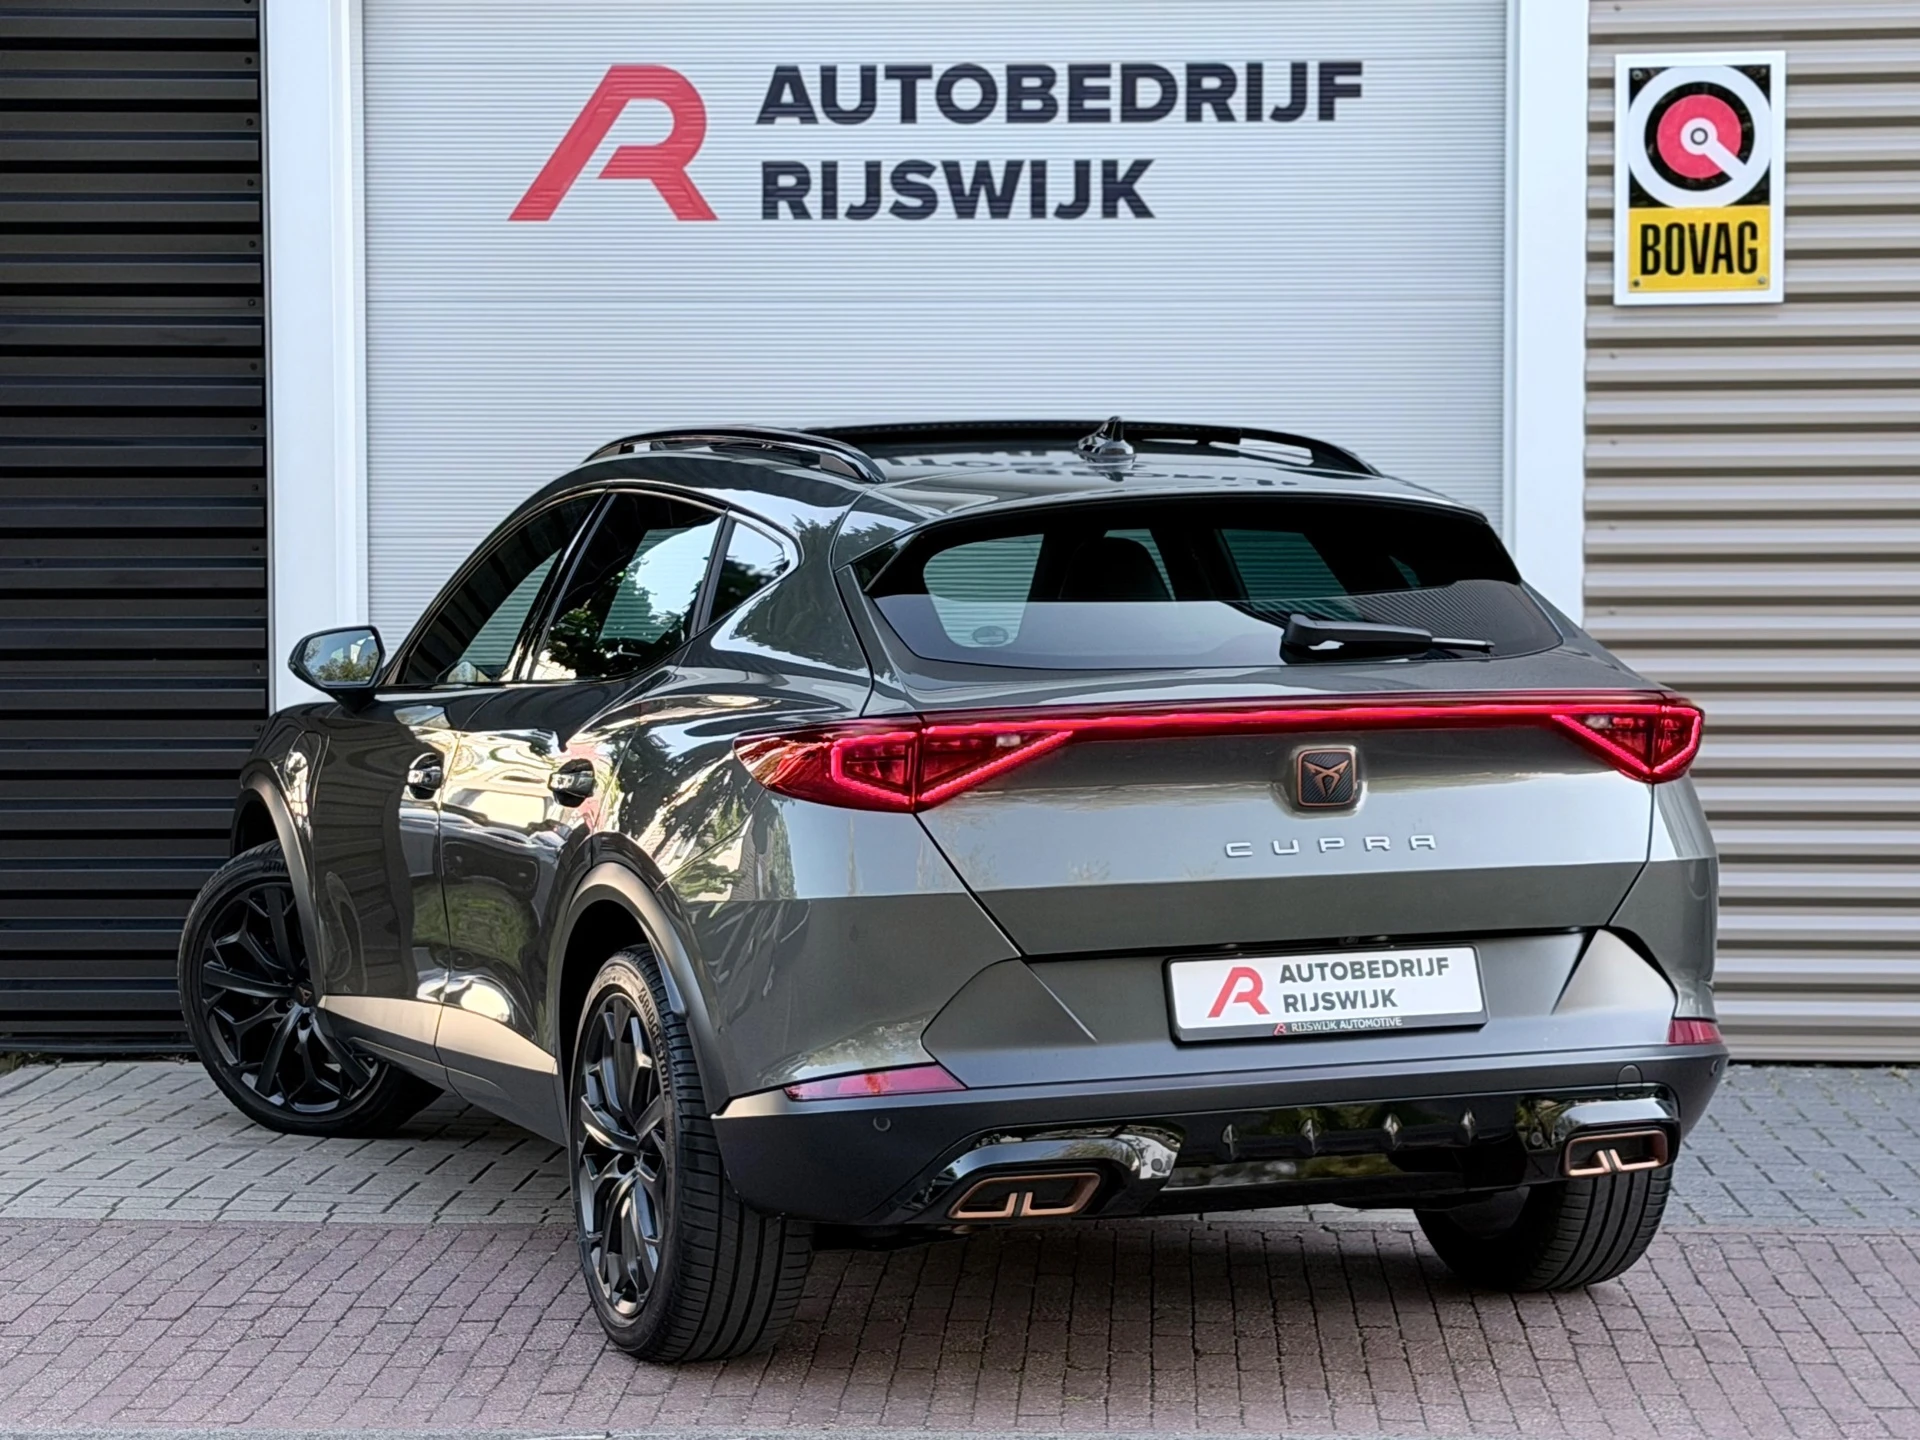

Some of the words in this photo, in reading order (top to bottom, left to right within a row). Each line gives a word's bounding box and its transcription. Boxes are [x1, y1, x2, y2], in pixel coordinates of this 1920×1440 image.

[755, 60, 1364, 125] AUTOBEDRIJF
[760, 158, 1156, 221] RIJSWIJK
[1640, 220, 1758, 276] BOVAG
[1225, 834, 1437, 857] CUPRA
[1279, 956, 1449, 984] AUTOBEDRIJF
[1283, 988, 1399, 1014] RIJSWIJK
[1291, 1020, 1338, 1032] RIJSWIJK
[1340, 1016, 1403, 1029] AUTOMOTIVE
